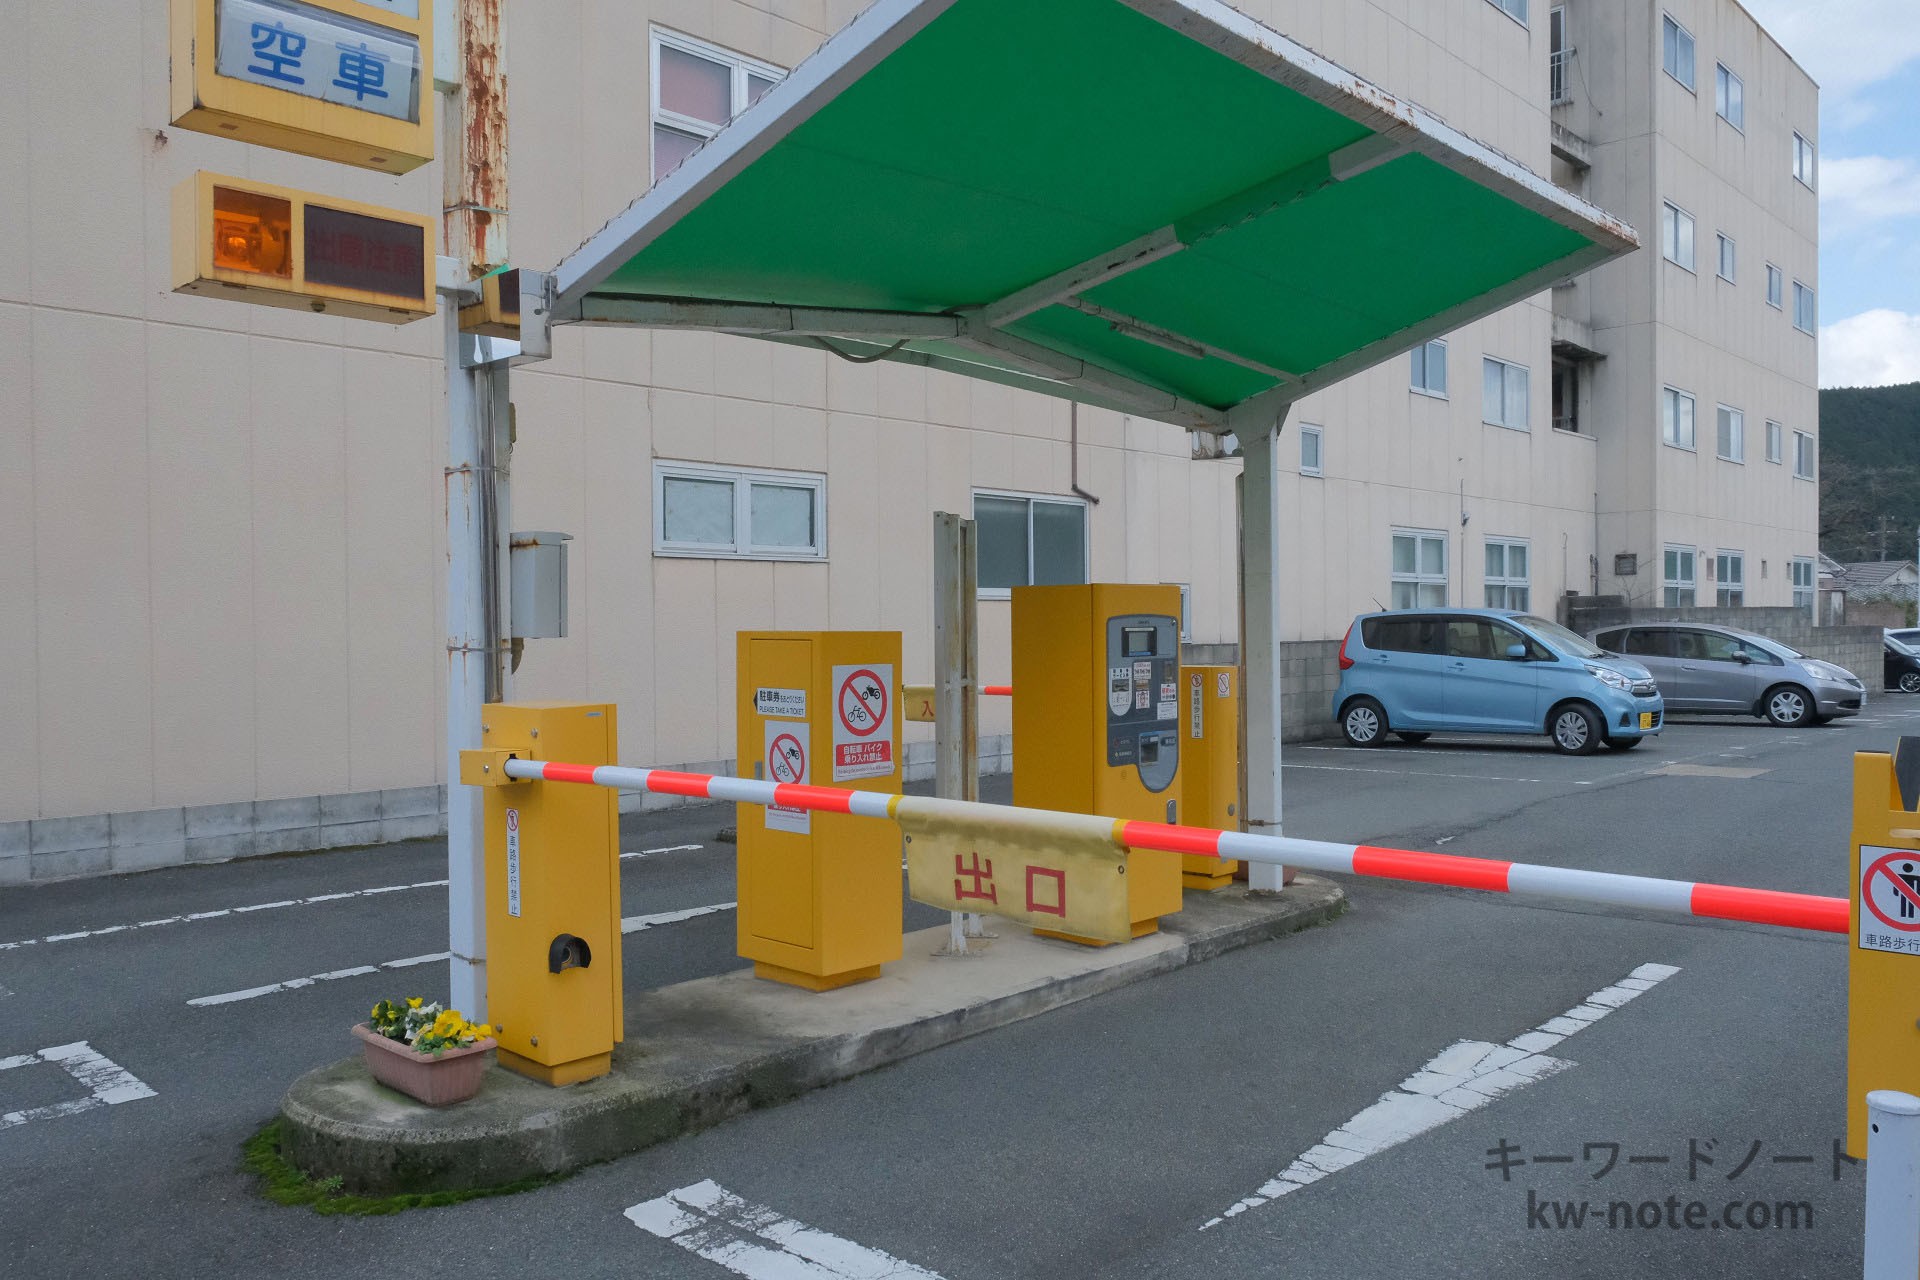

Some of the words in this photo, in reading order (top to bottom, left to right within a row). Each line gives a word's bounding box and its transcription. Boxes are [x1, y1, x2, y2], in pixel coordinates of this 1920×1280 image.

[247, 21, 391, 101] 空車
[759, 705, 775, 713] PLEASE
[775, 706, 786, 714] TAKE
[790, 707, 804, 716] TICKET
[843, 744, 863, 755] 自転車
[863, 743, 883, 753] バイク
[844, 752, 883, 764] 乗り入れ禁止
[954, 851, 1066, 918] 出口
